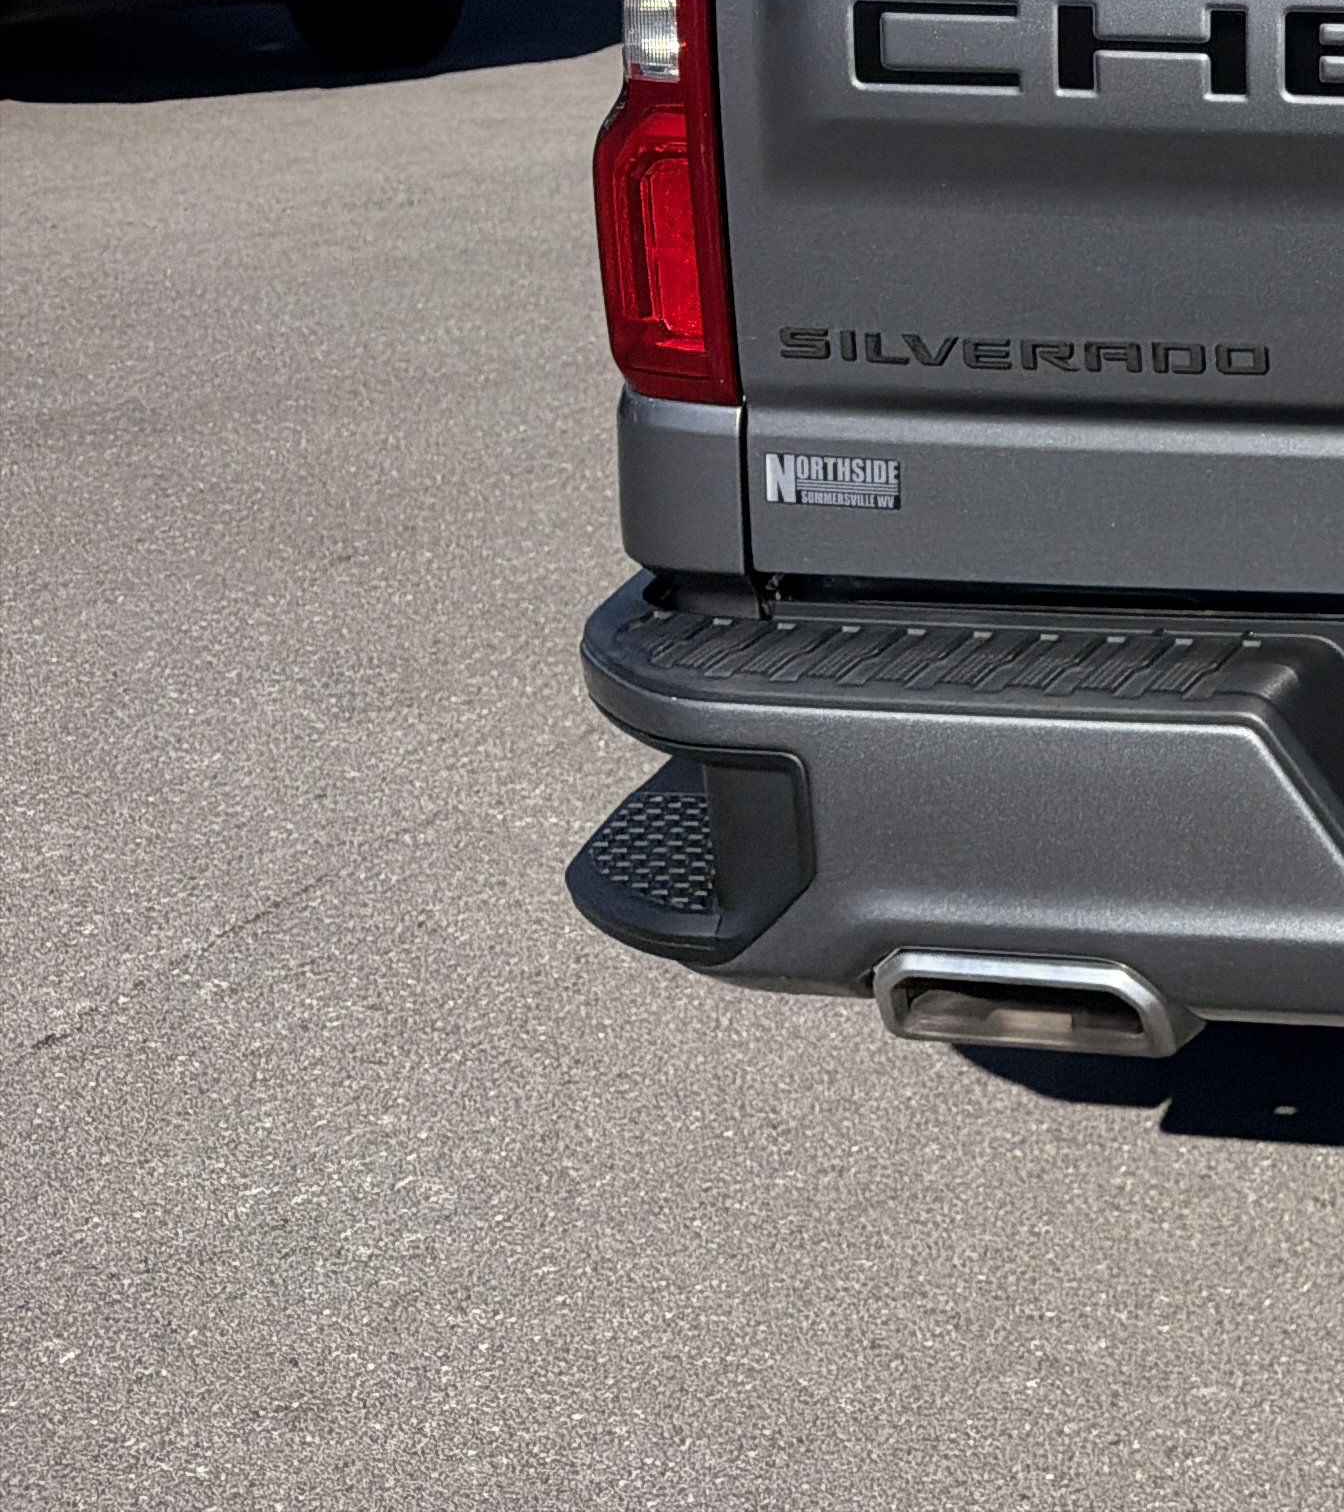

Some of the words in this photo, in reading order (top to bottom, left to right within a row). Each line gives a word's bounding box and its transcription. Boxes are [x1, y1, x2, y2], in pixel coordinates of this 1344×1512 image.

[779, 326, 1270, 377] SILVERADO
[765, 453, 898, 503] NORTHSIDE
[801, 491, 876, 507] SUMMERSVILLE
[877, 496, 895, 508] WV
